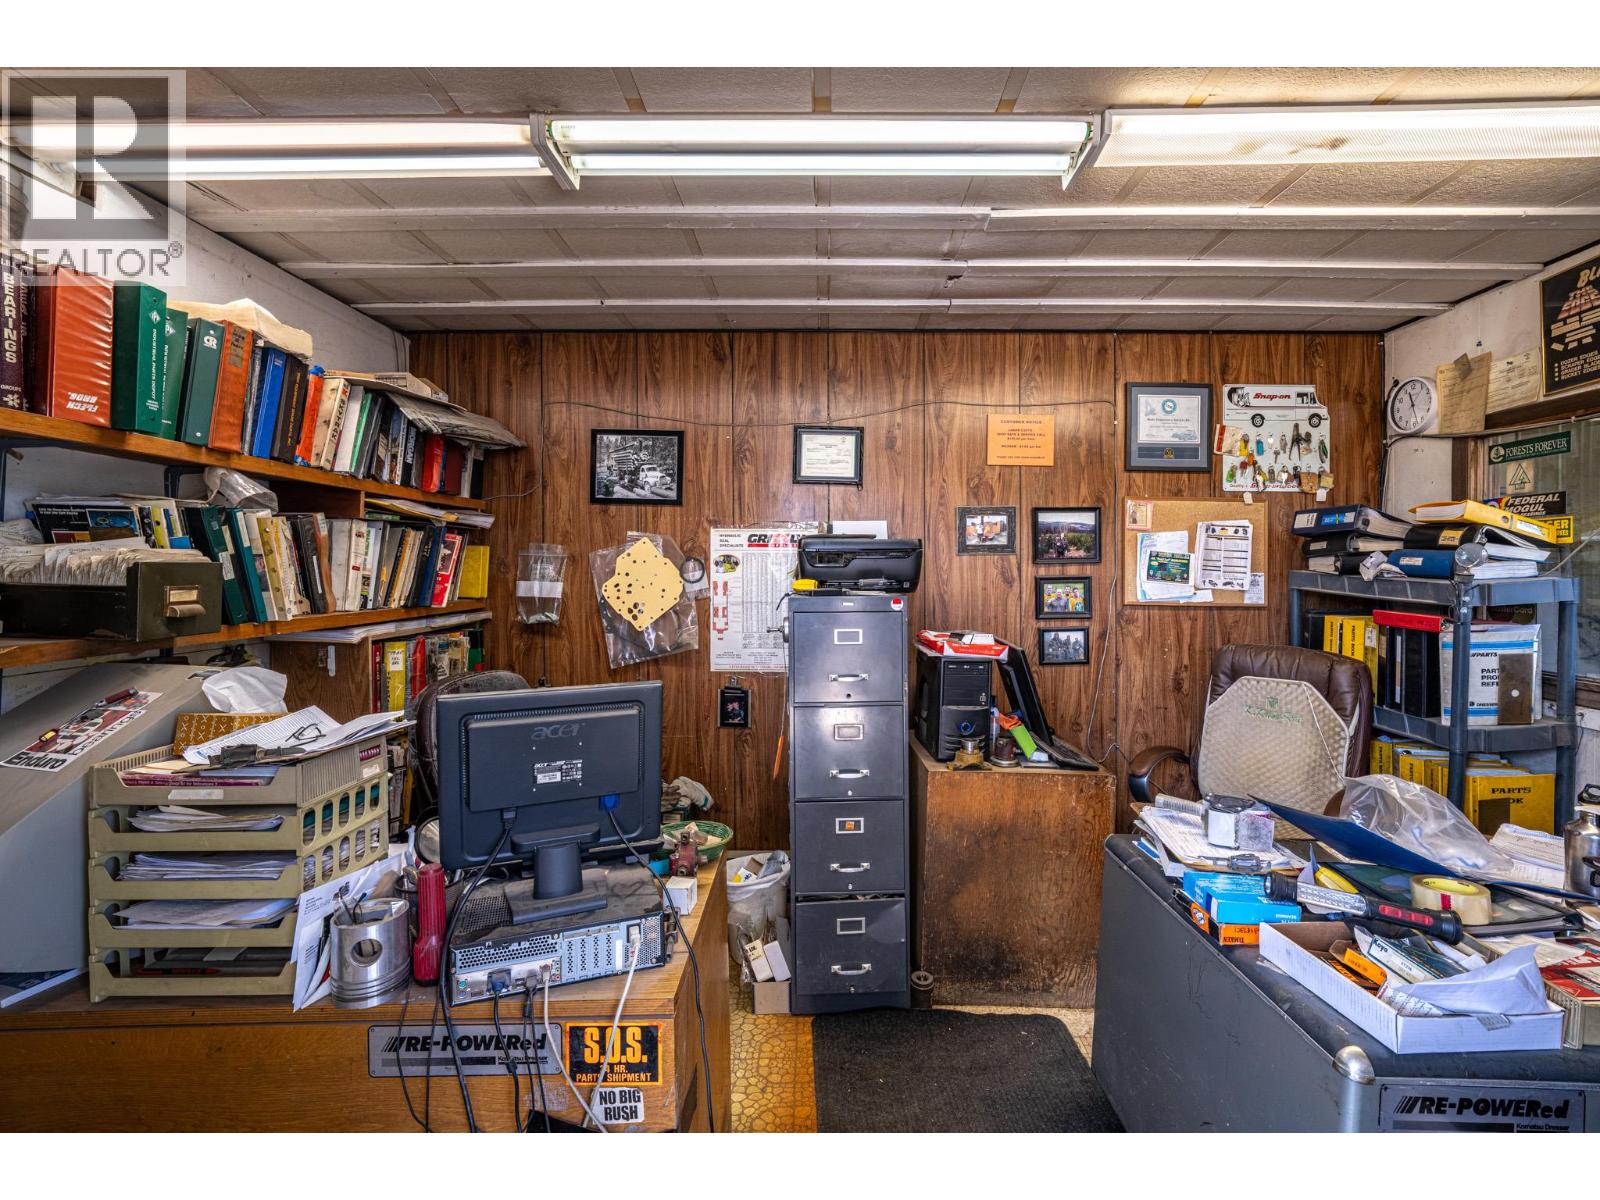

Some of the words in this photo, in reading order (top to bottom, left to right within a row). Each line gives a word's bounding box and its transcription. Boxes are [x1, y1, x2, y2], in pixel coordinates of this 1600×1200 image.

[3, 271, 17, 363] BEARINGS
[1253, 392, 1291, 401] Snap-on
[405, 426, 417, 464] MORGAN
[1505, 445, 1534, 458] FORESTS
[1534, 438, 1567, 452] FOREVER
[1507, 493, 1560, 505] FEDERAL
[1505, 503, 1545, 514] MOGUL
[531, 723, 580, 741] acer
[1491, 786, 1531, 794] PARTS
[1374, 939, 1389, 953] Koyo
[404, 1033, 547, 1052] RE-POWERed
[613, 1065, 629, 1073] HR.
[607, 1072, 652, 1082] SHIPMENT
[599, 1090, 617, 1106] NO
[619, 1089, 641, 1104] BIG
[604, 1105, 639, 1121] RUSH
[1418, 1096, 1570, 1119] RE-POWERed
[1516, 1123, 1544, 1131] Komatsu
[1545, 1123, 1570, 1131] Dresser
